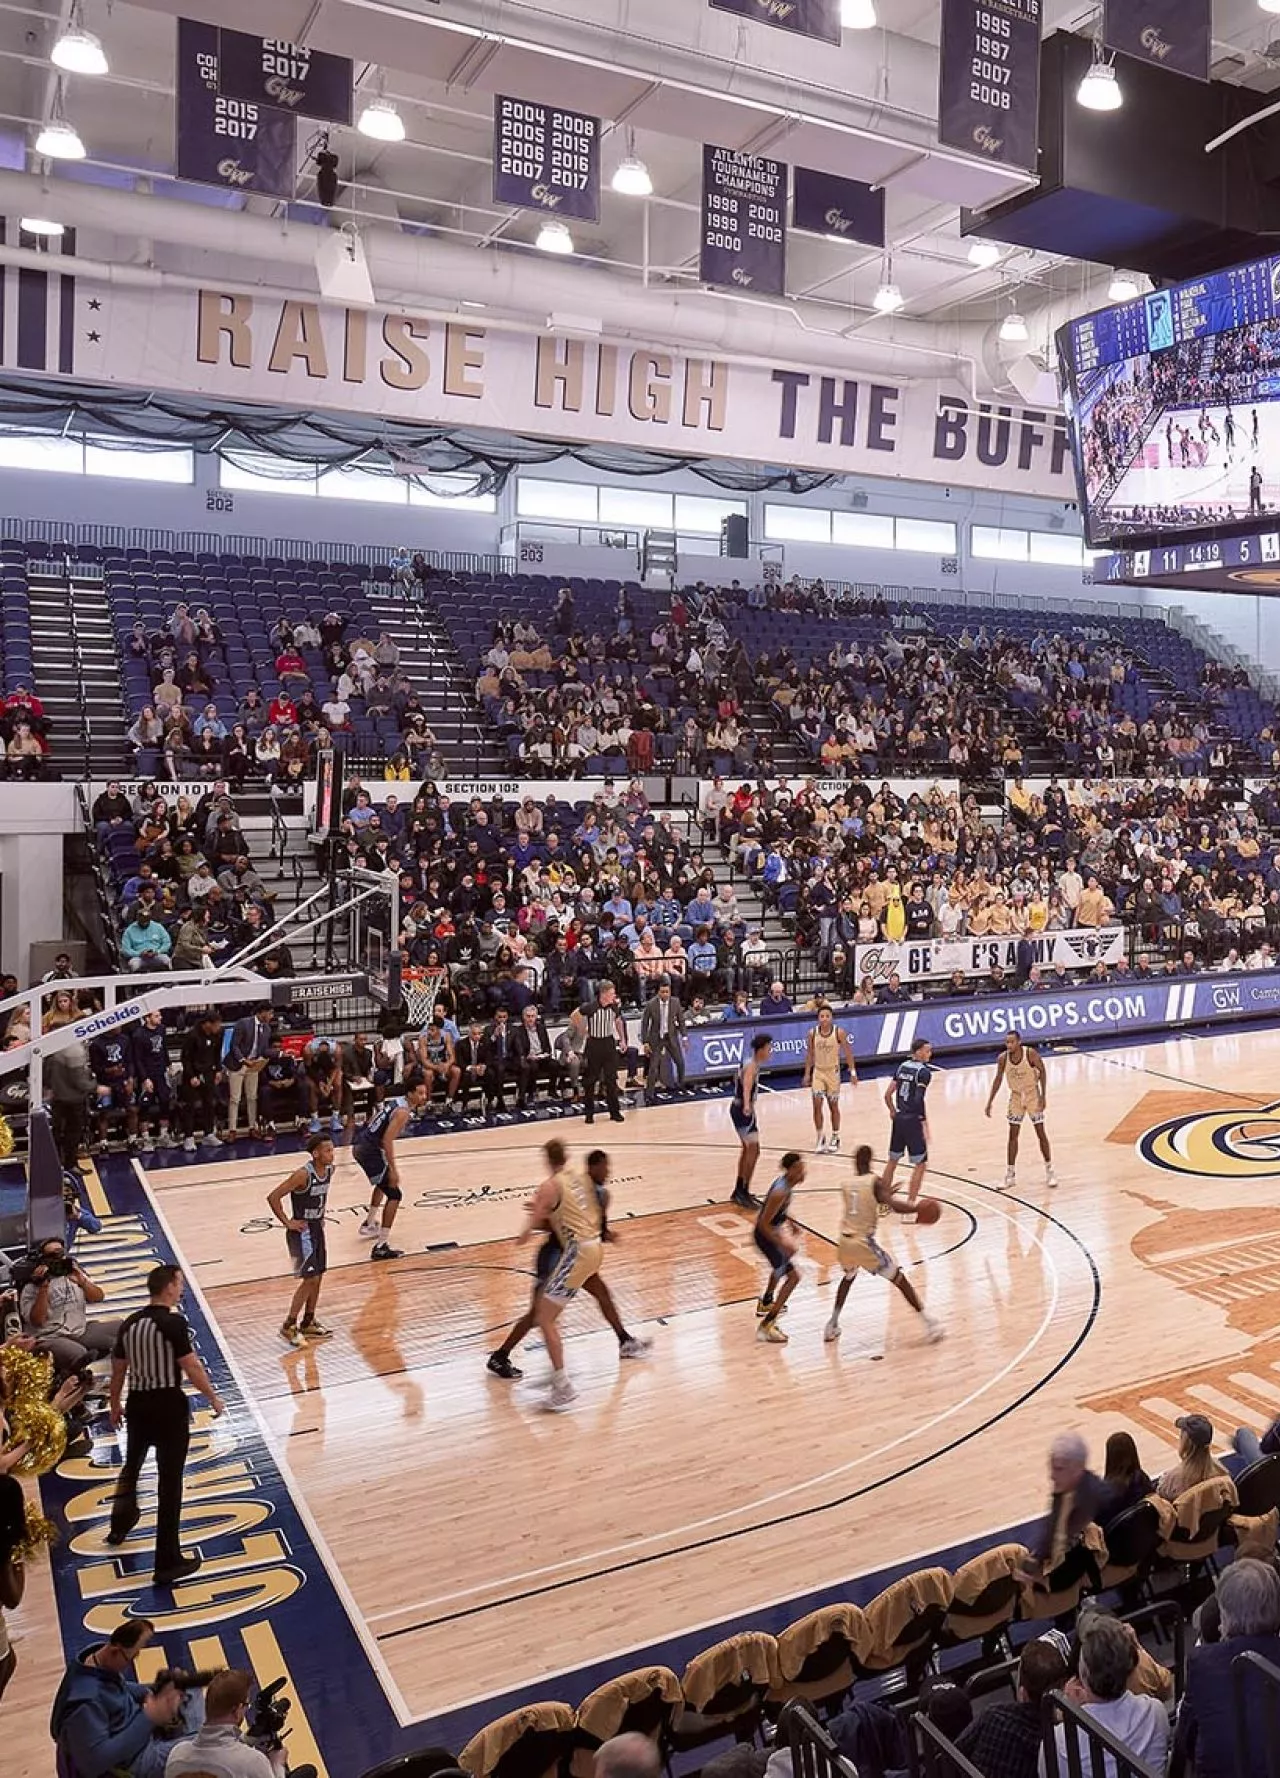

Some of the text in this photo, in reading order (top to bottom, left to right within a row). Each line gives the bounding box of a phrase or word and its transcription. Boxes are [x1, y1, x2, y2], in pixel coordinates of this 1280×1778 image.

[976, 11, 1010, 37] 1995
[976, 35, 1009, 61] 1997
[263, 54, 309, 81] 2017
[973, 58, 1011, 85] 2007
[971, 82, 1011, 109] 2008
[215, 97, 259, 121] 2015
[502, 101, 594, 137] 2004 2008
[215, 117, 257, 140] 2017
[502, 119, 589, 154] 2005 2015
[502, 138, 589, 173] 2006 2016
[713, 150, 777, 175] ATLANTIC 10
[502, 157, 588, 190] 2007 2017
[711, 159, 780, 187] TOURNAMENT
[715, 173, 775, 198] CHAMPIONS
[708, 193, 738, 214] 1998
[749, 204, 780, 224] 2001
[708, 212, 783, 244] 1999 2002
[707, 231, 741, 252] 2000
[197, 289, 485, 399] RAISE
[535, 335, 728, 432] HIGH
[771, 369, 899, 452] THE
[207, 498, 234, 512] 202
[520, 549, 543, 562] 203
[1189, 543, 1219, 563] 14:19
[1240, 541, 1249, 562] 5
[1267, 537, 1274, 550] 1
[1163, 551, 1177, 571] 11
[185, 784, 208, 795] 101
[445, 783, 519, 794] SECTION 102
[1006, 937, 1056, 968] AMY
[1213, 986, 1241, 1009] GW
[75, 1004, 141, 1038] Schelde
[945, 995, 1146, 1038] GWSHOPS.COM
[703, 1038, 744, 1065] GW
